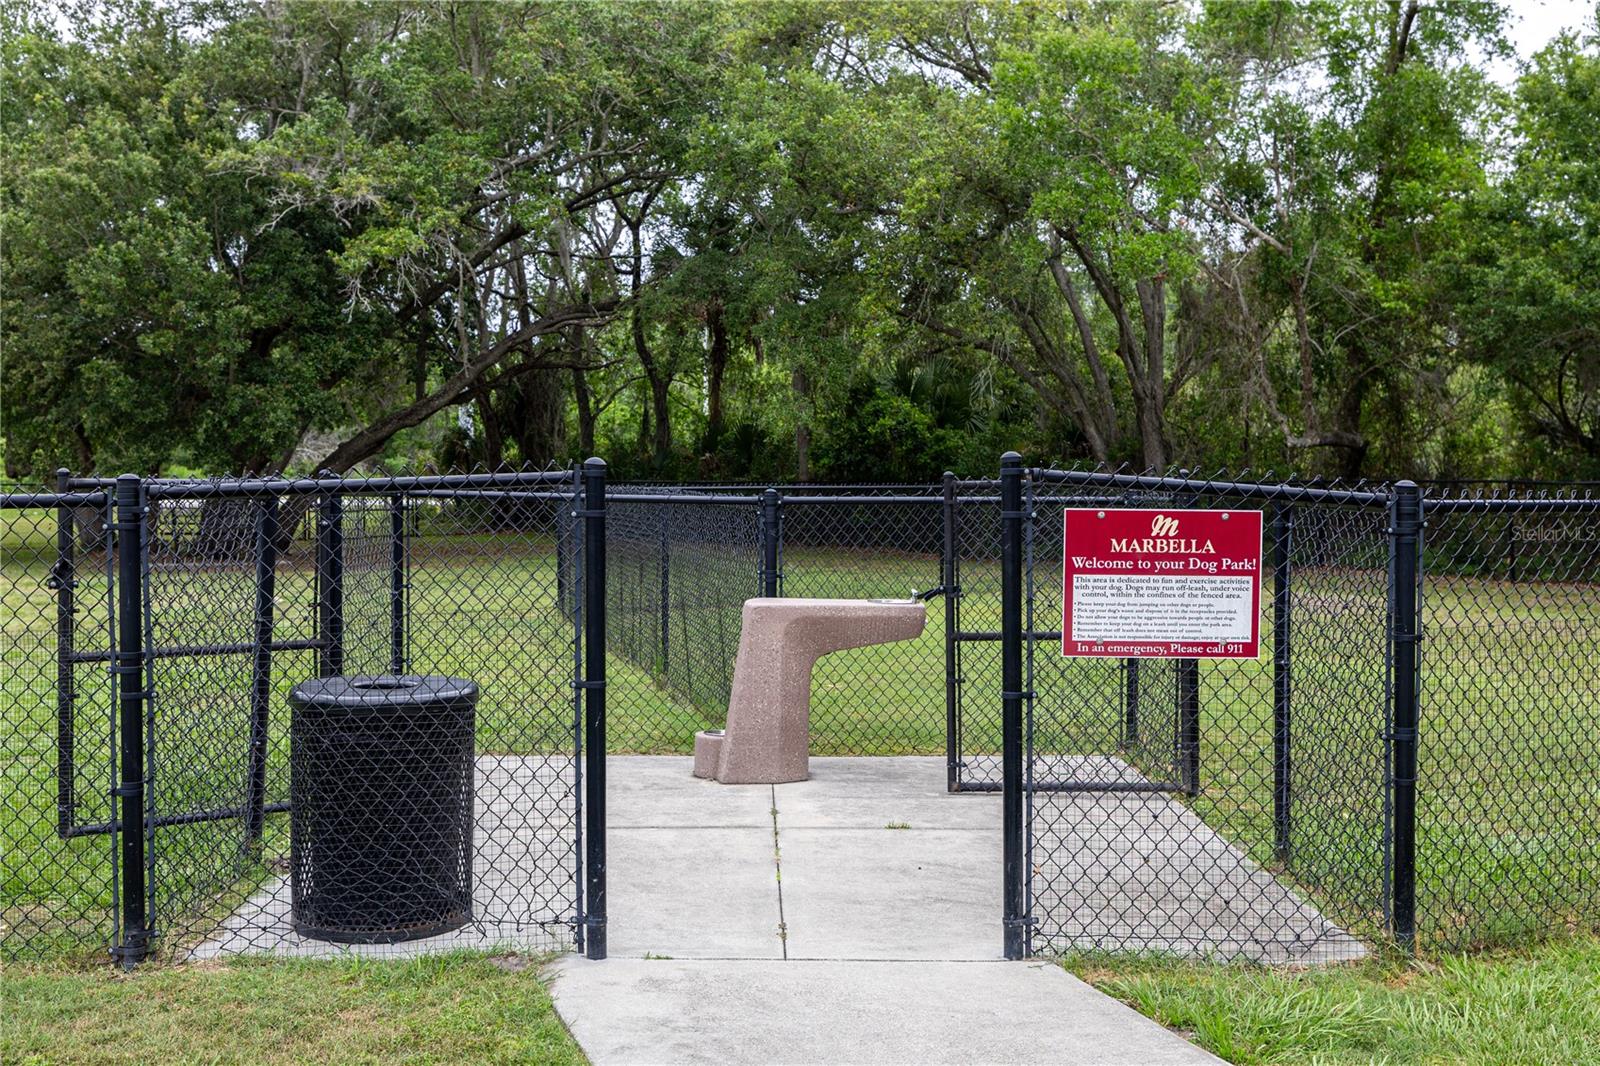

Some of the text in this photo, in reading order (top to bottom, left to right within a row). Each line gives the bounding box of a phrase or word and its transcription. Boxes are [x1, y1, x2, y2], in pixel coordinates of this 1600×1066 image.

[1110, 538, 1216, 554] MARBELLA
[1072, 557, 1256, 572] Welcome to your Dog Park!
[1075, 576, 1091, 584] This
[1174, 577, 1188, 585] and
[1109, 584, 1124, 593] dog.
[1125, 585, 1144, 593] Dogs
[1176, 584, 1208, 593] off-leash,
[1077, 643, 1244, 655] In an emergency, Please call 911
